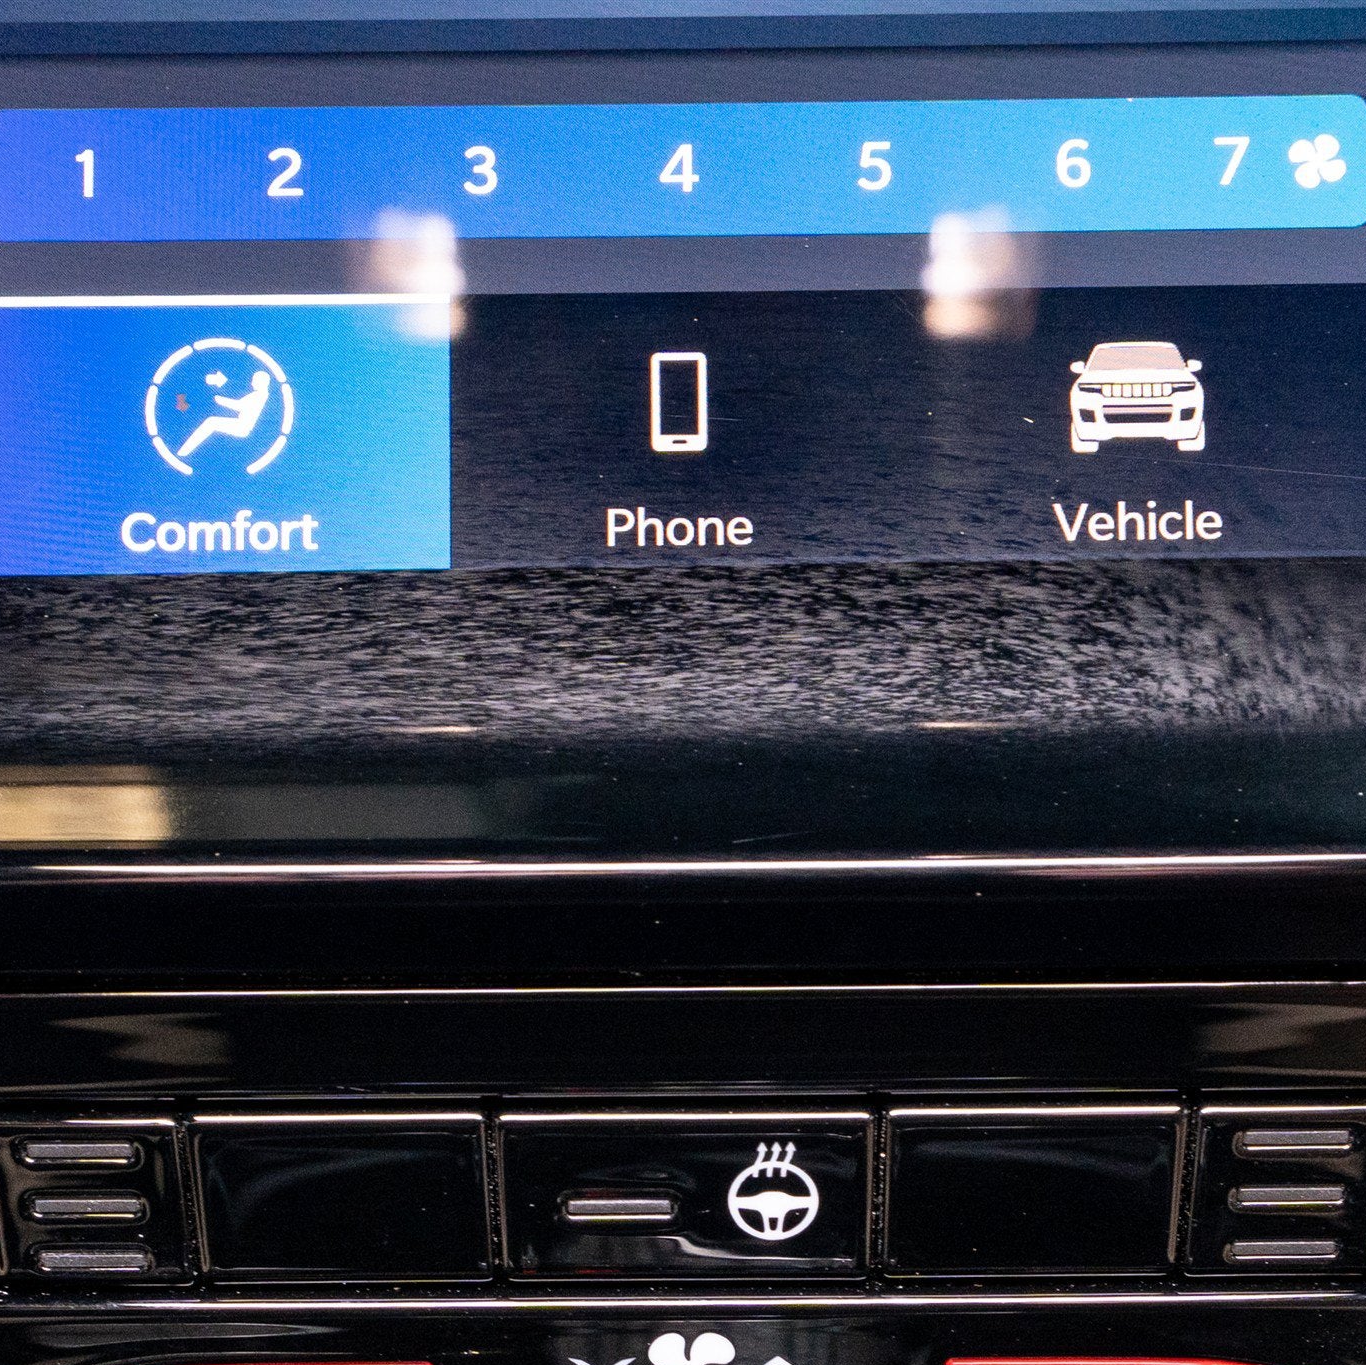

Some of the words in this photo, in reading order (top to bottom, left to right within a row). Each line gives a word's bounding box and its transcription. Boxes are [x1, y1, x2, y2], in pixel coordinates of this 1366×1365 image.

[75, 149, 94, 198] 1
[267, 147, 304, 199] 2
[463, 145, 498, 196] 3
[659, 143, 699, 194] 4
[857, 141, 892, 192] 5
[1055, 138, 1091, 189] 6
[1214, 136, 1250, 186] 7
[120, 509, 320, 553] Comfort
[608, 507, 753, 547] Phone
[1053, 500, 1222, 542] Vehicle
